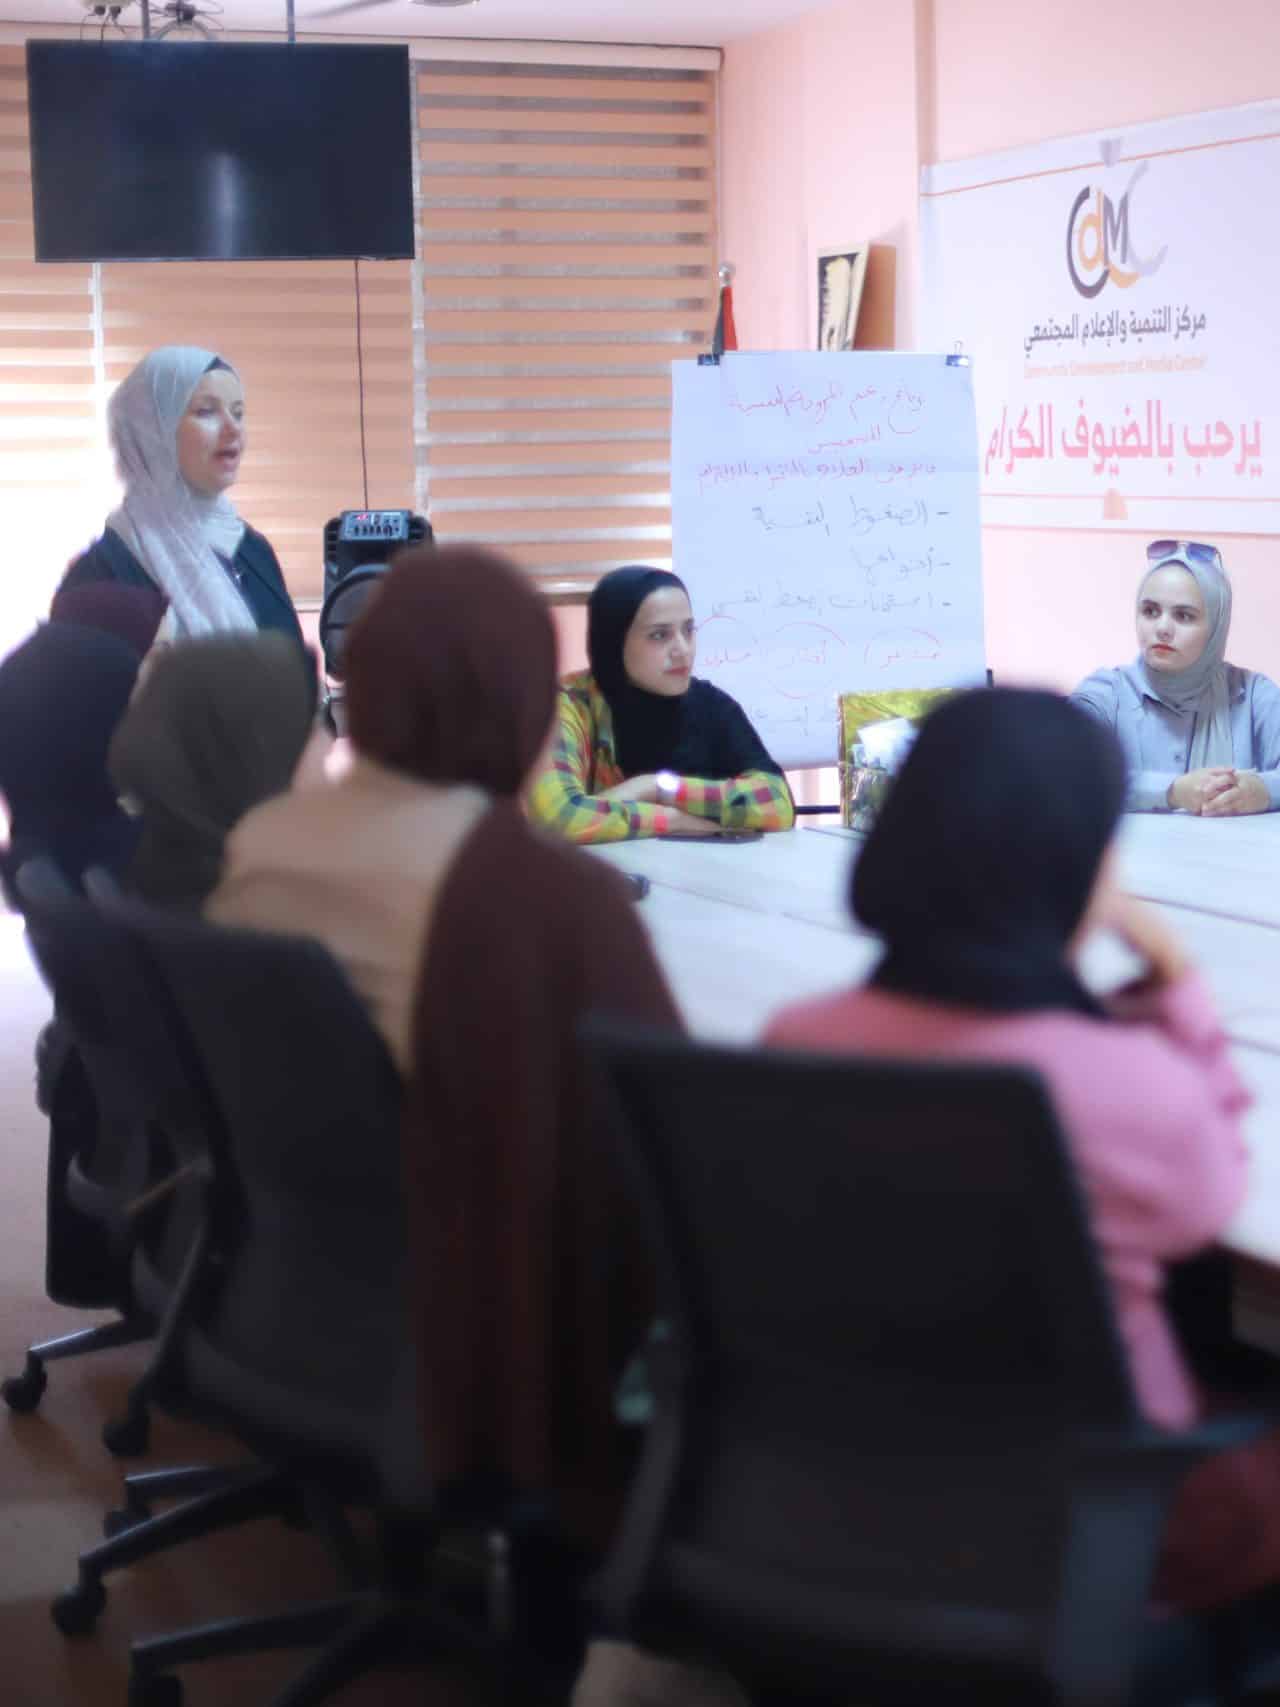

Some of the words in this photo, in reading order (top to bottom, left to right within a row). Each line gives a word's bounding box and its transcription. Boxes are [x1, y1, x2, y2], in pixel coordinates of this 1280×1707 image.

[1129, 305, 1172, 343] التنمية
[1174, 304, 1207, 341] مركز
[984, 399, 1054, 476] الكرام
[1061, 397, 1175, 477] بالضيوف
[1182, 418, 1264, 477] يرحب
